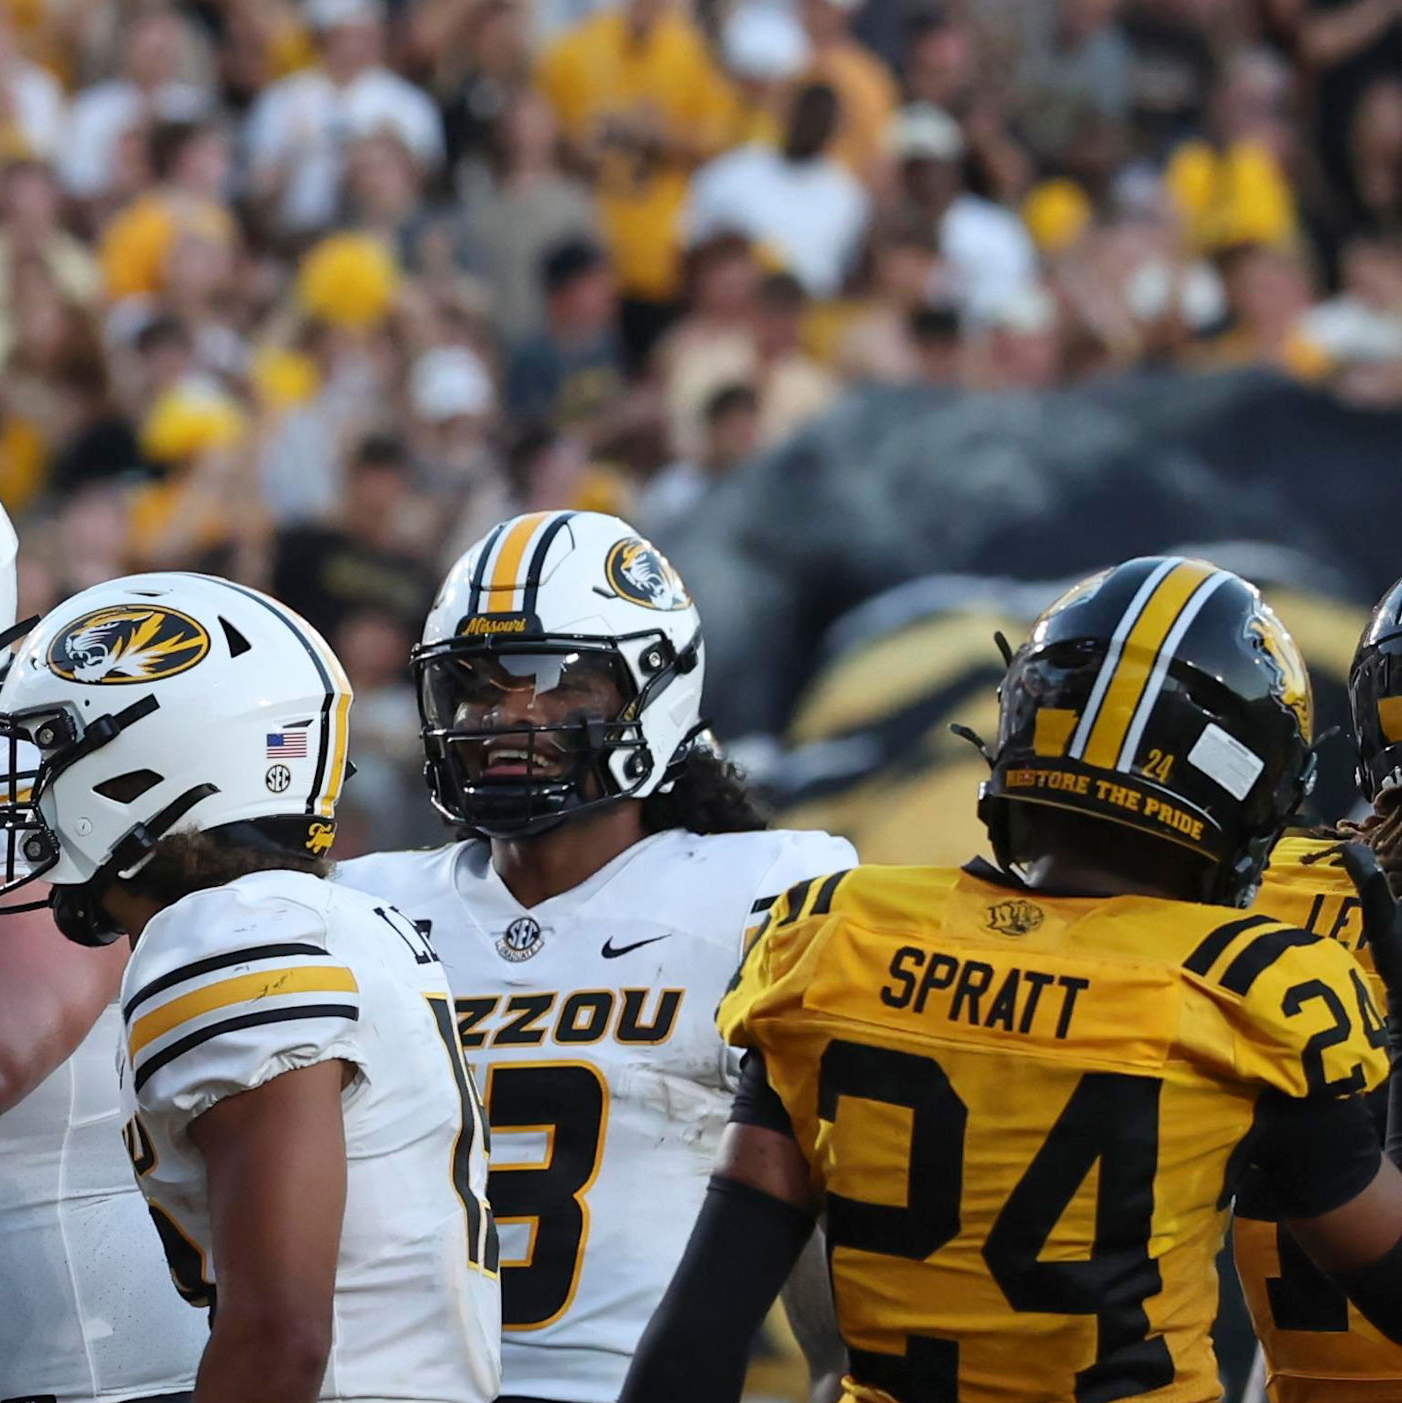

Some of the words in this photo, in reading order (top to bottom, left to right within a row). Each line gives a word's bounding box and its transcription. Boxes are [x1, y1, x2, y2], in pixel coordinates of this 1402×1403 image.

[462, 617, 527, 636] Missouri
[266, 765, 291, 793] SEC
[1142, 749, 1174, 784] 24
[1096, 778, 1142, 812] THE
[1144, 797, 1206, 841] PRIDE
[507, 919, 538, 949] SEC
[453, 988, 686, 1046] ZZOU
[879, 945, 1091, 1040] SPRATT
[1281, 968, 1389, 1099] 24
[467, 1059, 610, 1332] 3
